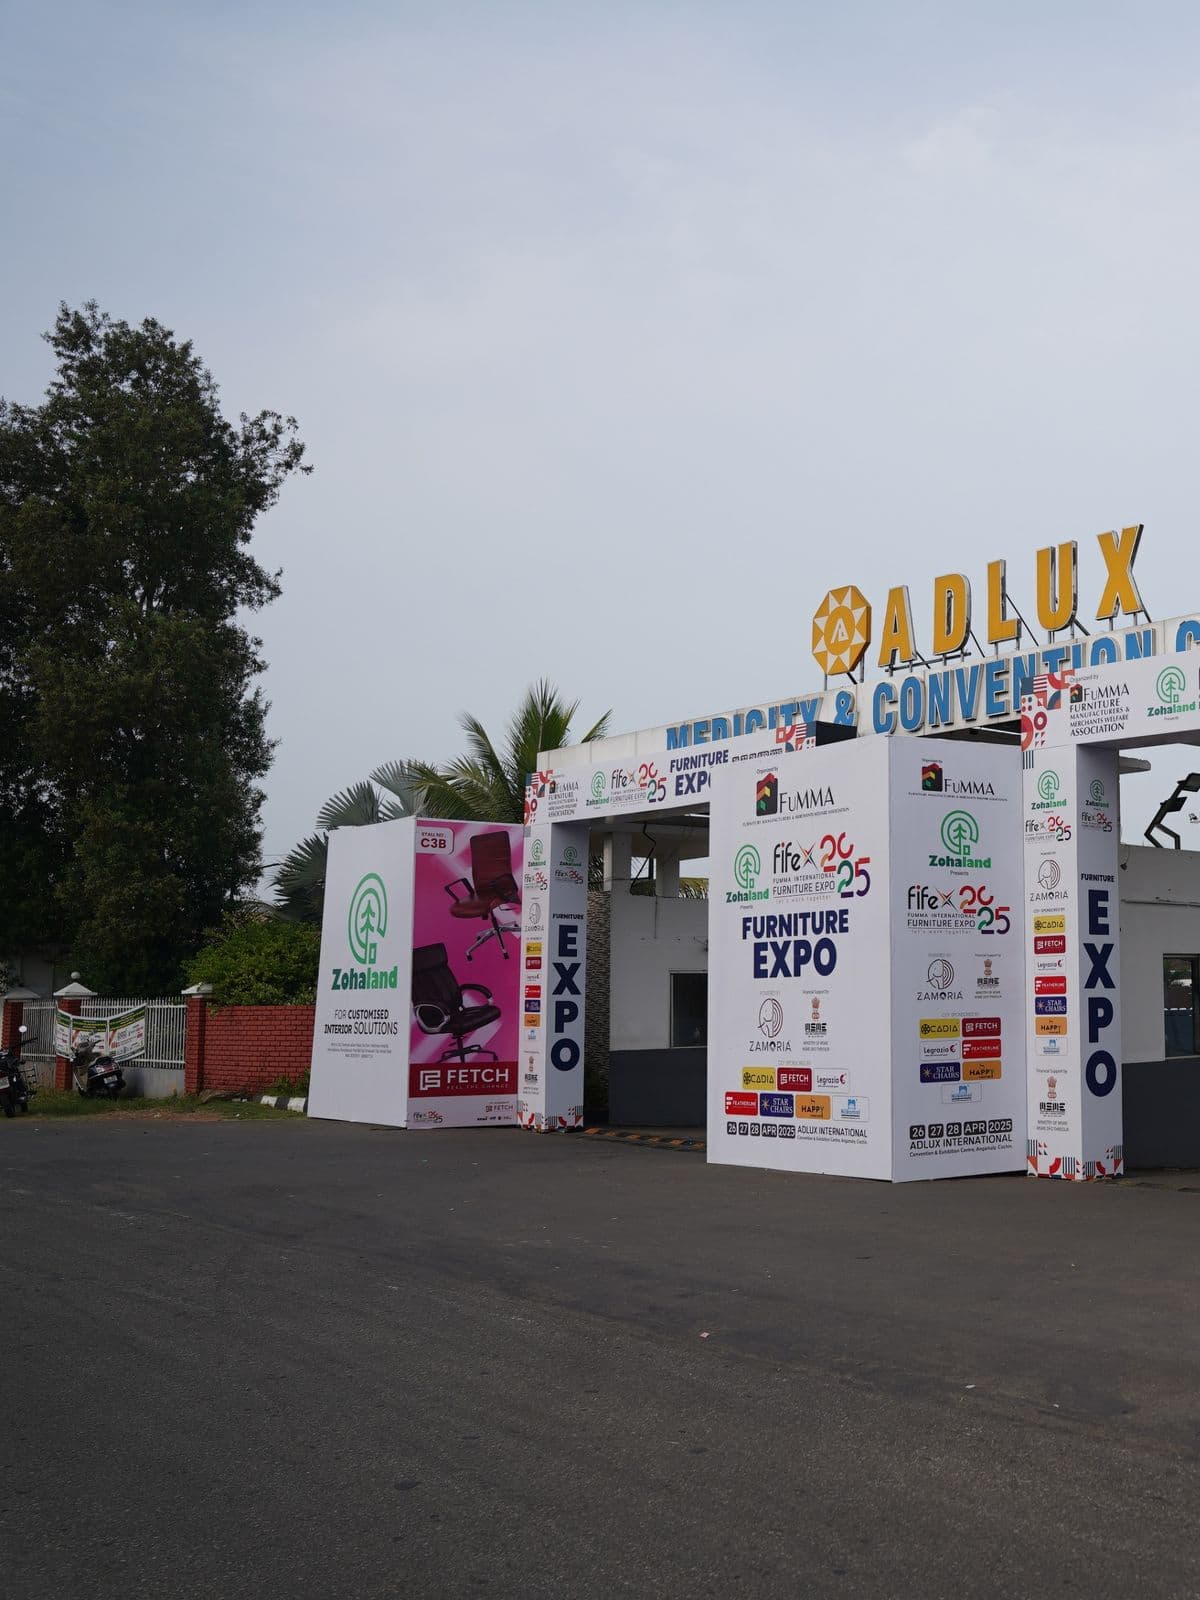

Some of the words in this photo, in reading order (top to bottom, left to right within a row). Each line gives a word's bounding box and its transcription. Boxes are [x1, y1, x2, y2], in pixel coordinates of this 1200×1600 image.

[878, 523, 1144, 668] ADLUX
[1069, 698, 1120, 713] FURNITURE
[1147, 702, 1196, 717] Zohaland
[1070, 722, 1125, 737] ASSOCIATION
[670, 749, 729, 773] FURNITURE
[675, 770, 711, 796] EXP
[1031, 799, 1067, 811] Zohaland
[421, 838, 446, 848] C3B
[928, 855, 992, 868] Zohaland
[1081, 873, 1115, 882] FURNITURE
[773, 883, 813, 896] FURNITURE
[815, 880, 835, 891] EXPO
[726, 888, 769, 903] Zohaland
[1030, 890, 1069, 902] ZAMORIA
[742, 909, 849, 940] FURNITURE
[907, 919, 951, 927] FURNITURE
[954, 920, 976, 928] EXPO
[753, 937, 837, 979] EXPO
[331, 966, 398, 991] Zohaland
[917, 991, 963, 1001] ZAMORIA
[335, 1009, 347, 1019] FOR
[348, 1009, 389, 1020] CUSTOMISED
[324, 1023, 352, 1034] INTERIOR
[353, 1021, 398, 1035] SOLUTIONS
[749, 1040, 792, 1052] ZAMORIA
[447, 1068, 509, 1083] FETCH
[788, 1074, 809, 1083] FETCH
[761, 1125, 776, 1134] APR
[779, 1126, 795, 1136] 2025
[819, 1127, 867, 1138] INTERNATIONAL
[964, 1122, 986, 1133] APR
[989, 1120, 1012, 1132] 2025
[910, 1140, 940, 1150] ADLUX
[943, 1134, 1012, 1147] INTERNATIONAL
